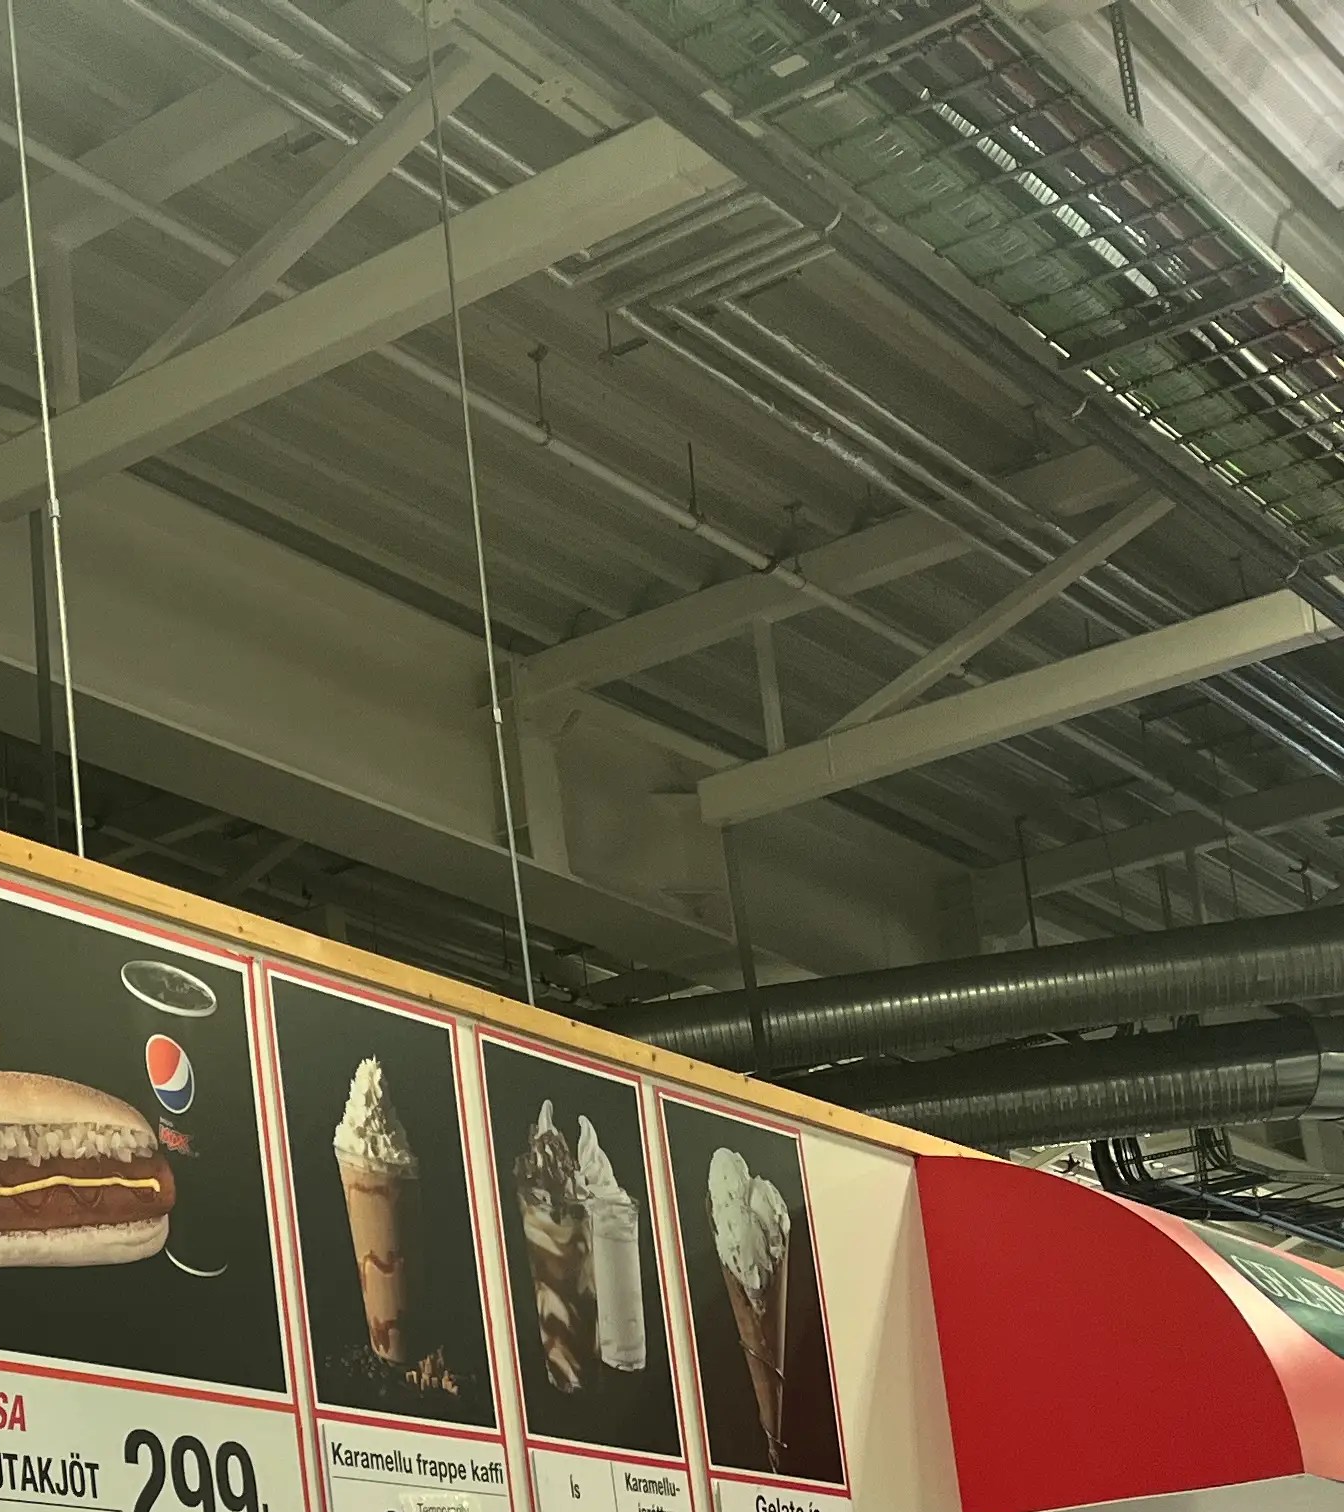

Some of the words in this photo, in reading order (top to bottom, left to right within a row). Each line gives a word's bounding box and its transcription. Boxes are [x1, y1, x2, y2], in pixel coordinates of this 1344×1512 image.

[331, 1442, 413, 1474] Karamellu
[416, 1453, 467, 1484] frappe
[470, 1459, 504, 1484] kaffi
